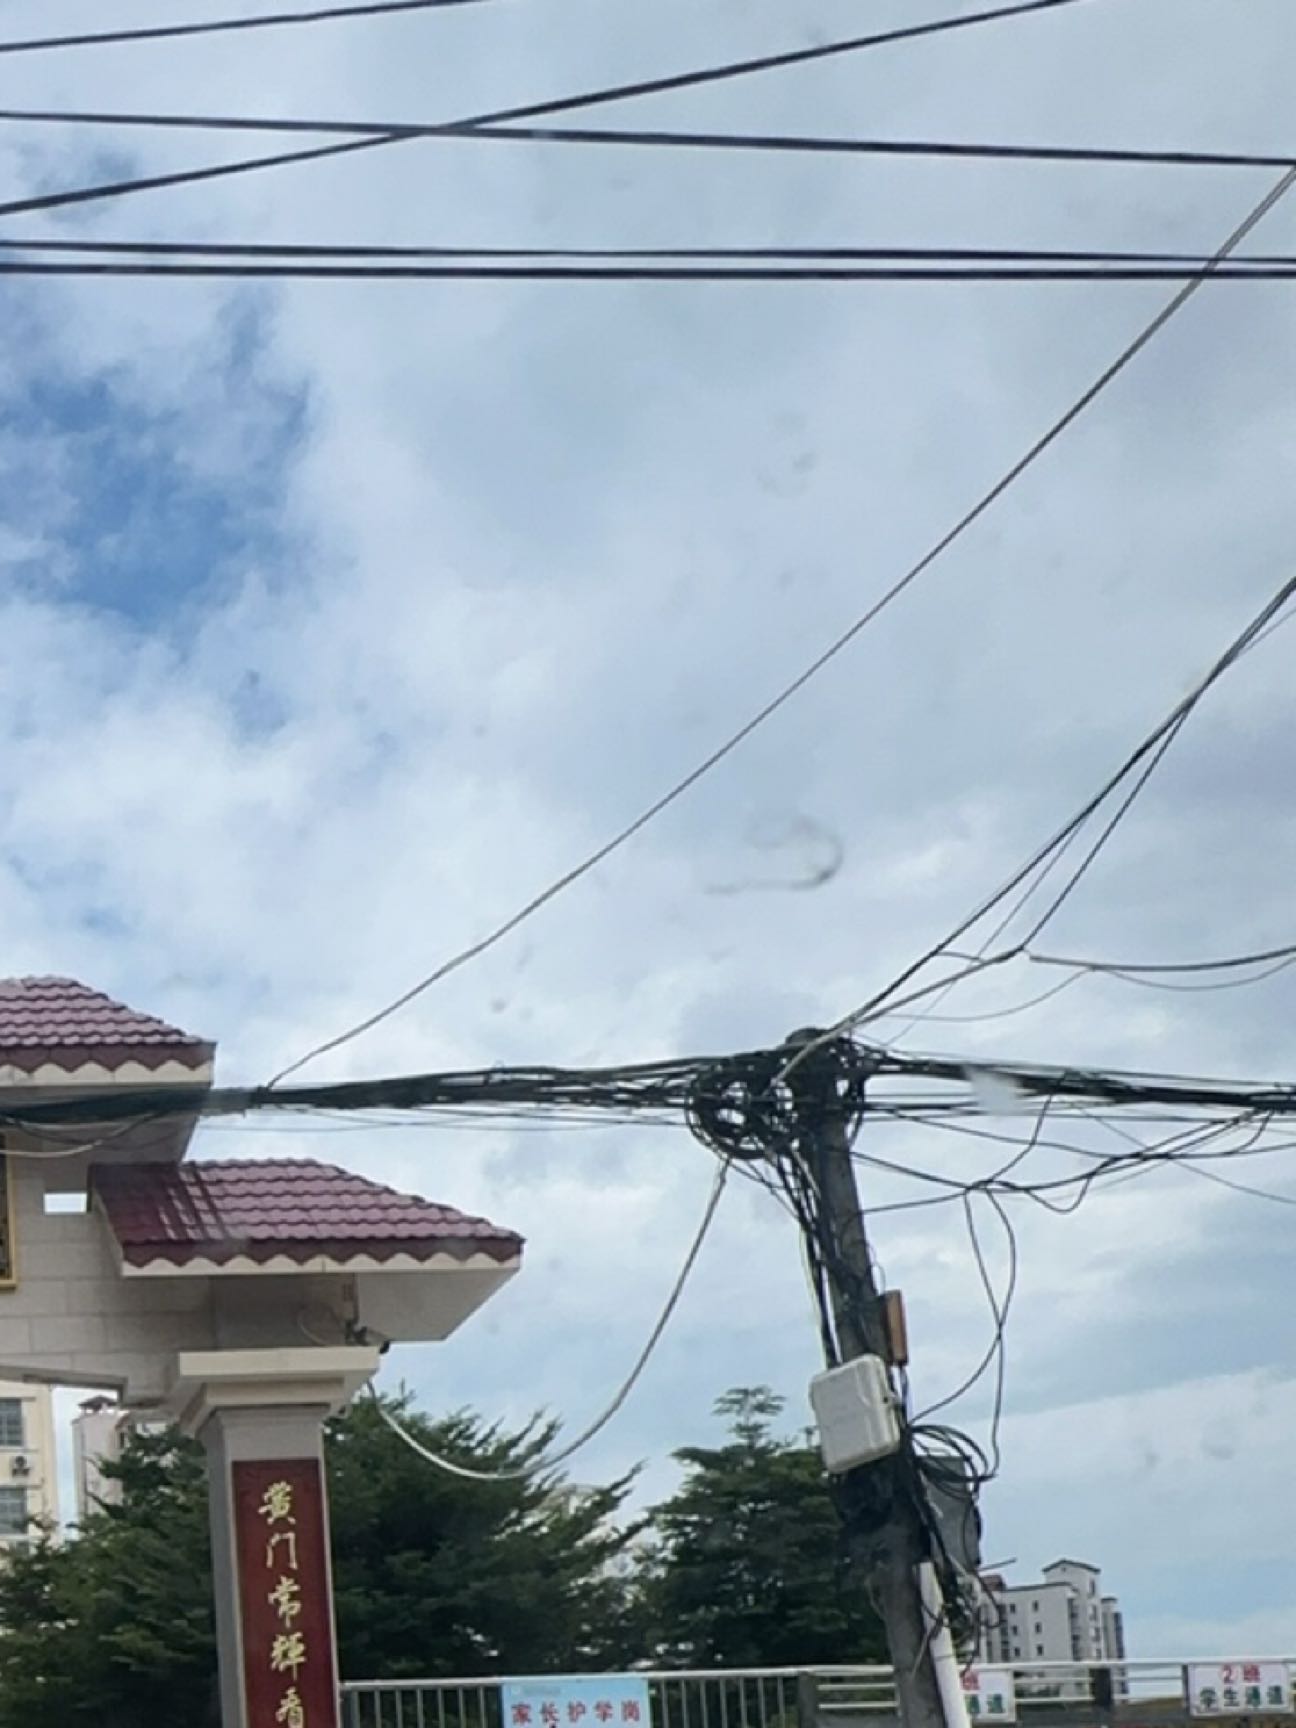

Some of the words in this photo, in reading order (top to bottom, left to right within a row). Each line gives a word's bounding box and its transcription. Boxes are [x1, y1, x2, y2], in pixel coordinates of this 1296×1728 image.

[510, 1698, 641, 1728] 家长护学岗
